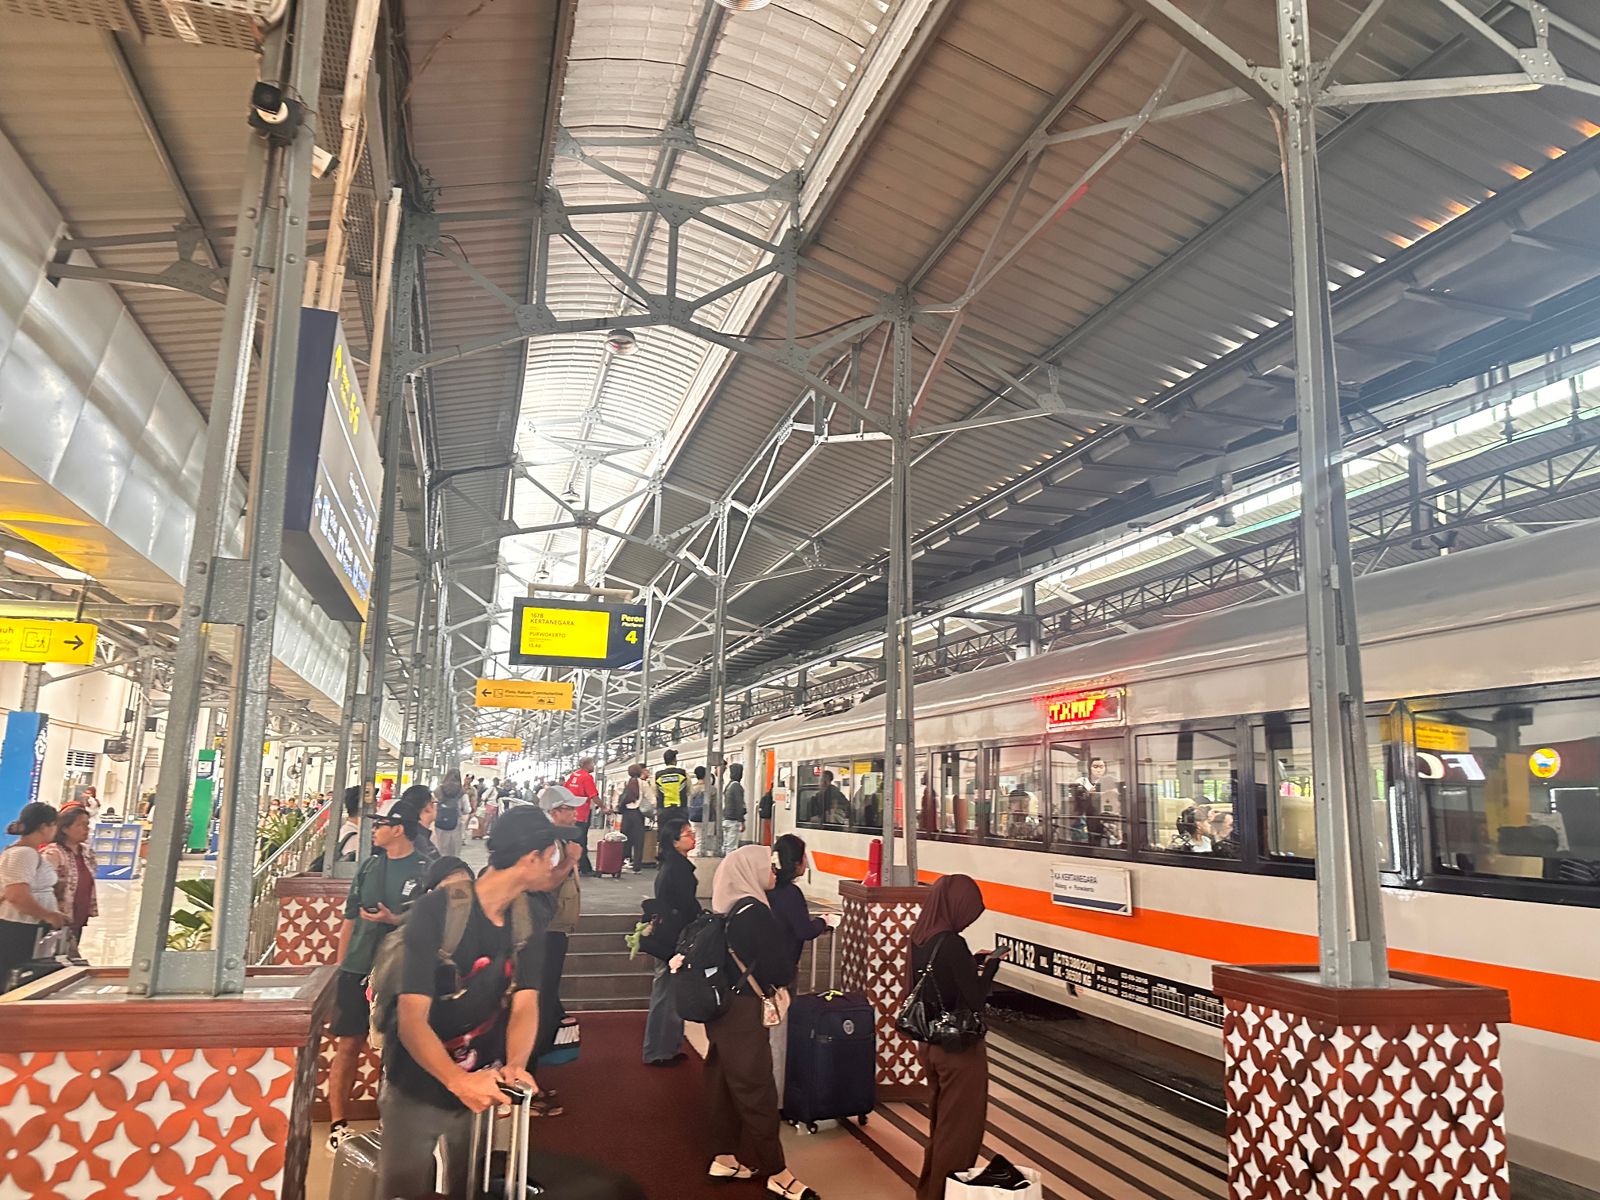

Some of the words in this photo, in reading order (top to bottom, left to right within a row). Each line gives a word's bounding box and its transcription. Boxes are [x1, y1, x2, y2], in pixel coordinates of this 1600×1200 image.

[530, 618, 575, 626] KERTANEGARA
[621, 613, 645, 622] Peron
[624, 630, 638, 645] 4
